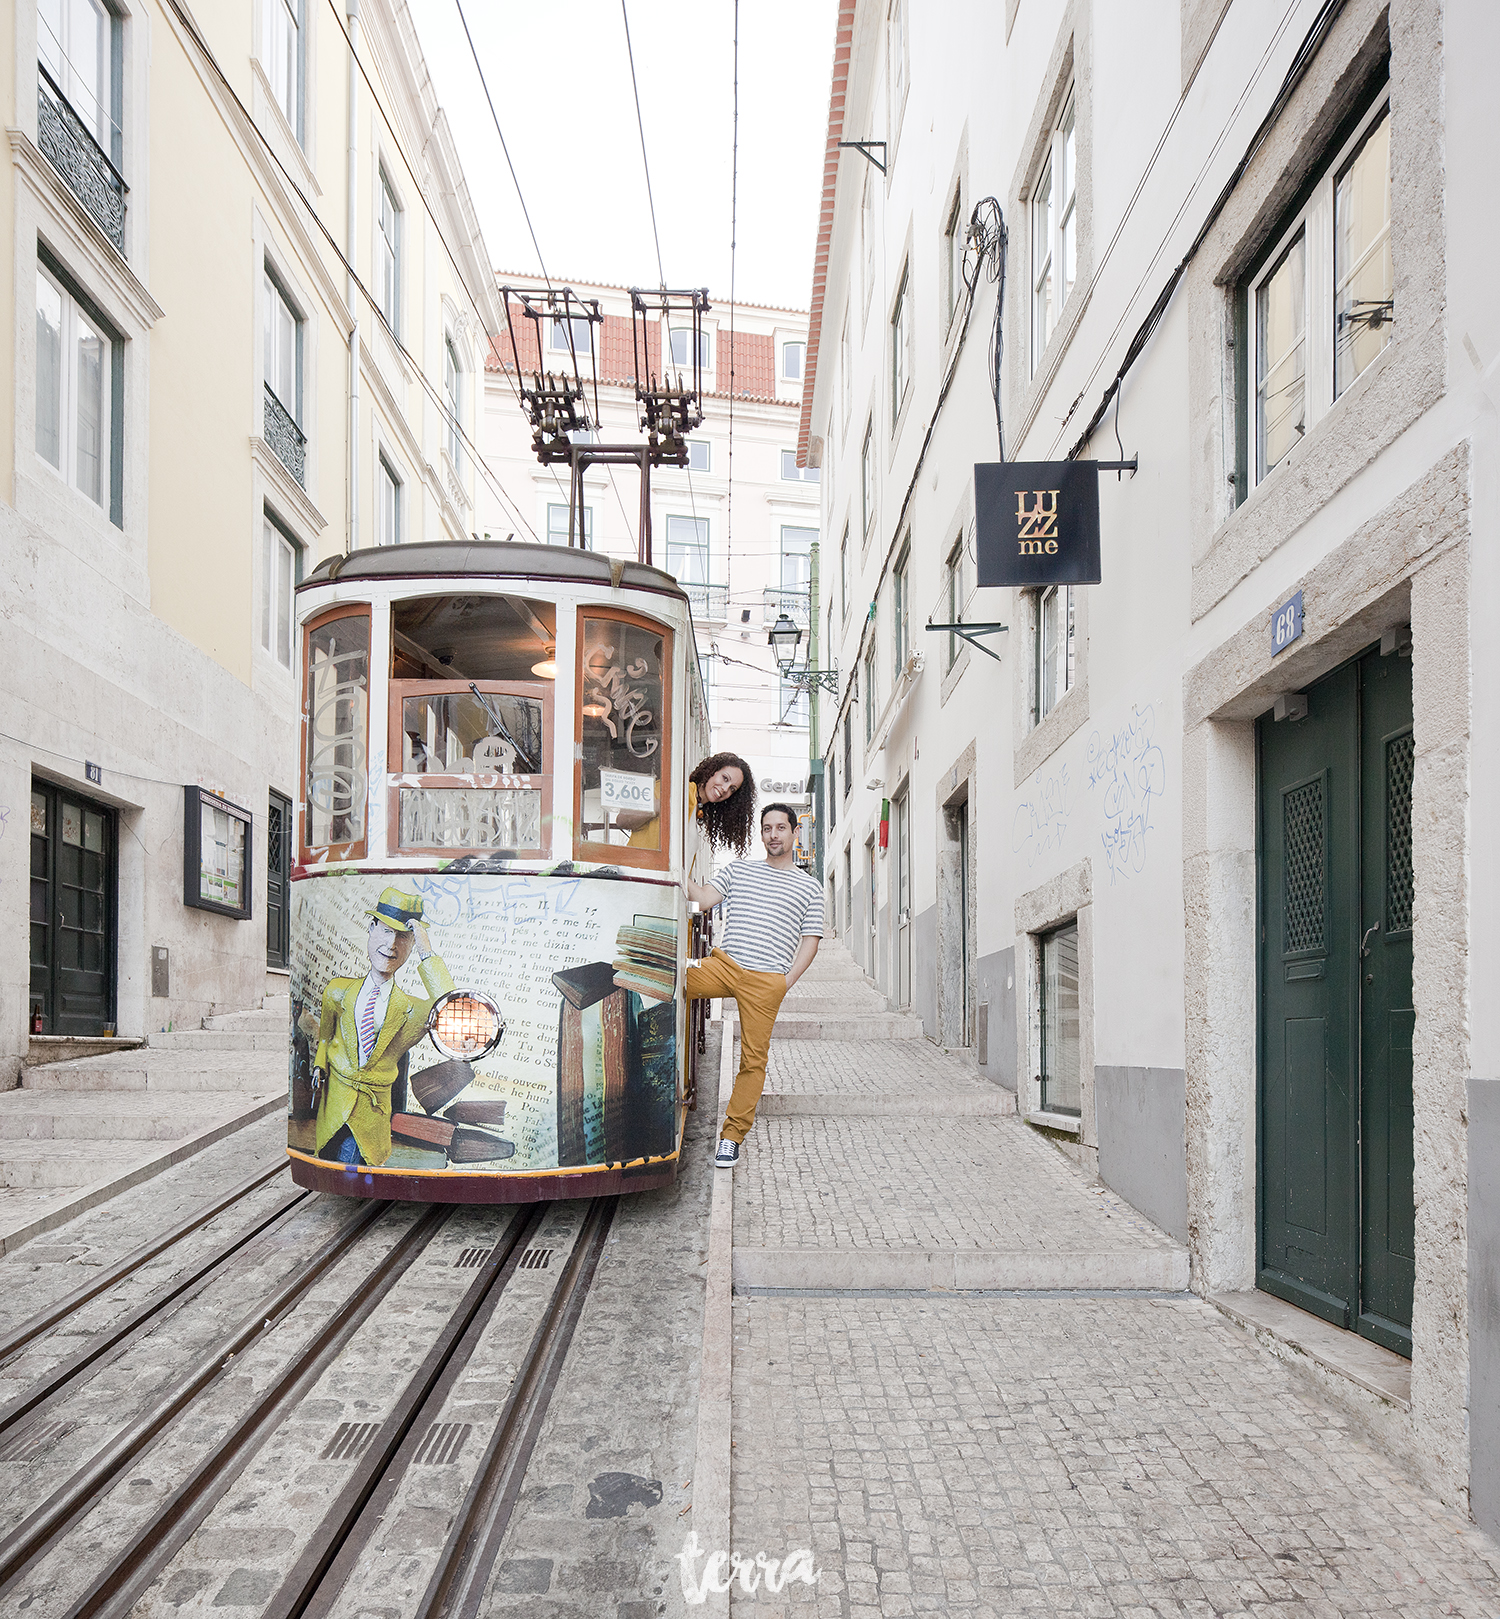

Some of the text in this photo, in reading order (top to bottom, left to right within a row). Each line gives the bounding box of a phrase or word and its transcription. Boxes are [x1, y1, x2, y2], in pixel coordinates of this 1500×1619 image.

[1018, 539, 1058, 555] me
[1276, 605, 1295, 645] 68
[90, 764, 99, 782] 81
[605, 782, 651, 801] 3,60€
[760, 778, 804, 794] Geral
[552, 917, 558, 925] e
[563, 919, 579, 927] me
[434, 928, 450, 938] elle
[453, 931, 467, 940] me
[523, 940, 538, 948] me
[543, 929, 550, 937] e
[556, 930, 569, 938] eu
[575, 931, 599, 941] ouvi
[466, 941, 478, 951] do
[529, 951, 542, 960] eu
[549, 953, 559, 961] te
[564, 955, 591, 964] man-
[480, 967, 513, 979] retirou
[520, 971, 531, 981] de
[515, 982, 532, 992] dia
[503, 993, 528, 1004] feito
[536, 998, 558, 1009] com
[521, 1018, 532, 1027] te
[518, 1040, 533, 1051] Tu
[513, 1052, 529, 1063] diz
[535, 1058, 541, 1066] o
[485, 1069, 508, 1081] elles
[510, 1087, 524, 1099] he
[526, 1091, 550, 1104] hum
[521, 1102, 540, 1113] Po-
